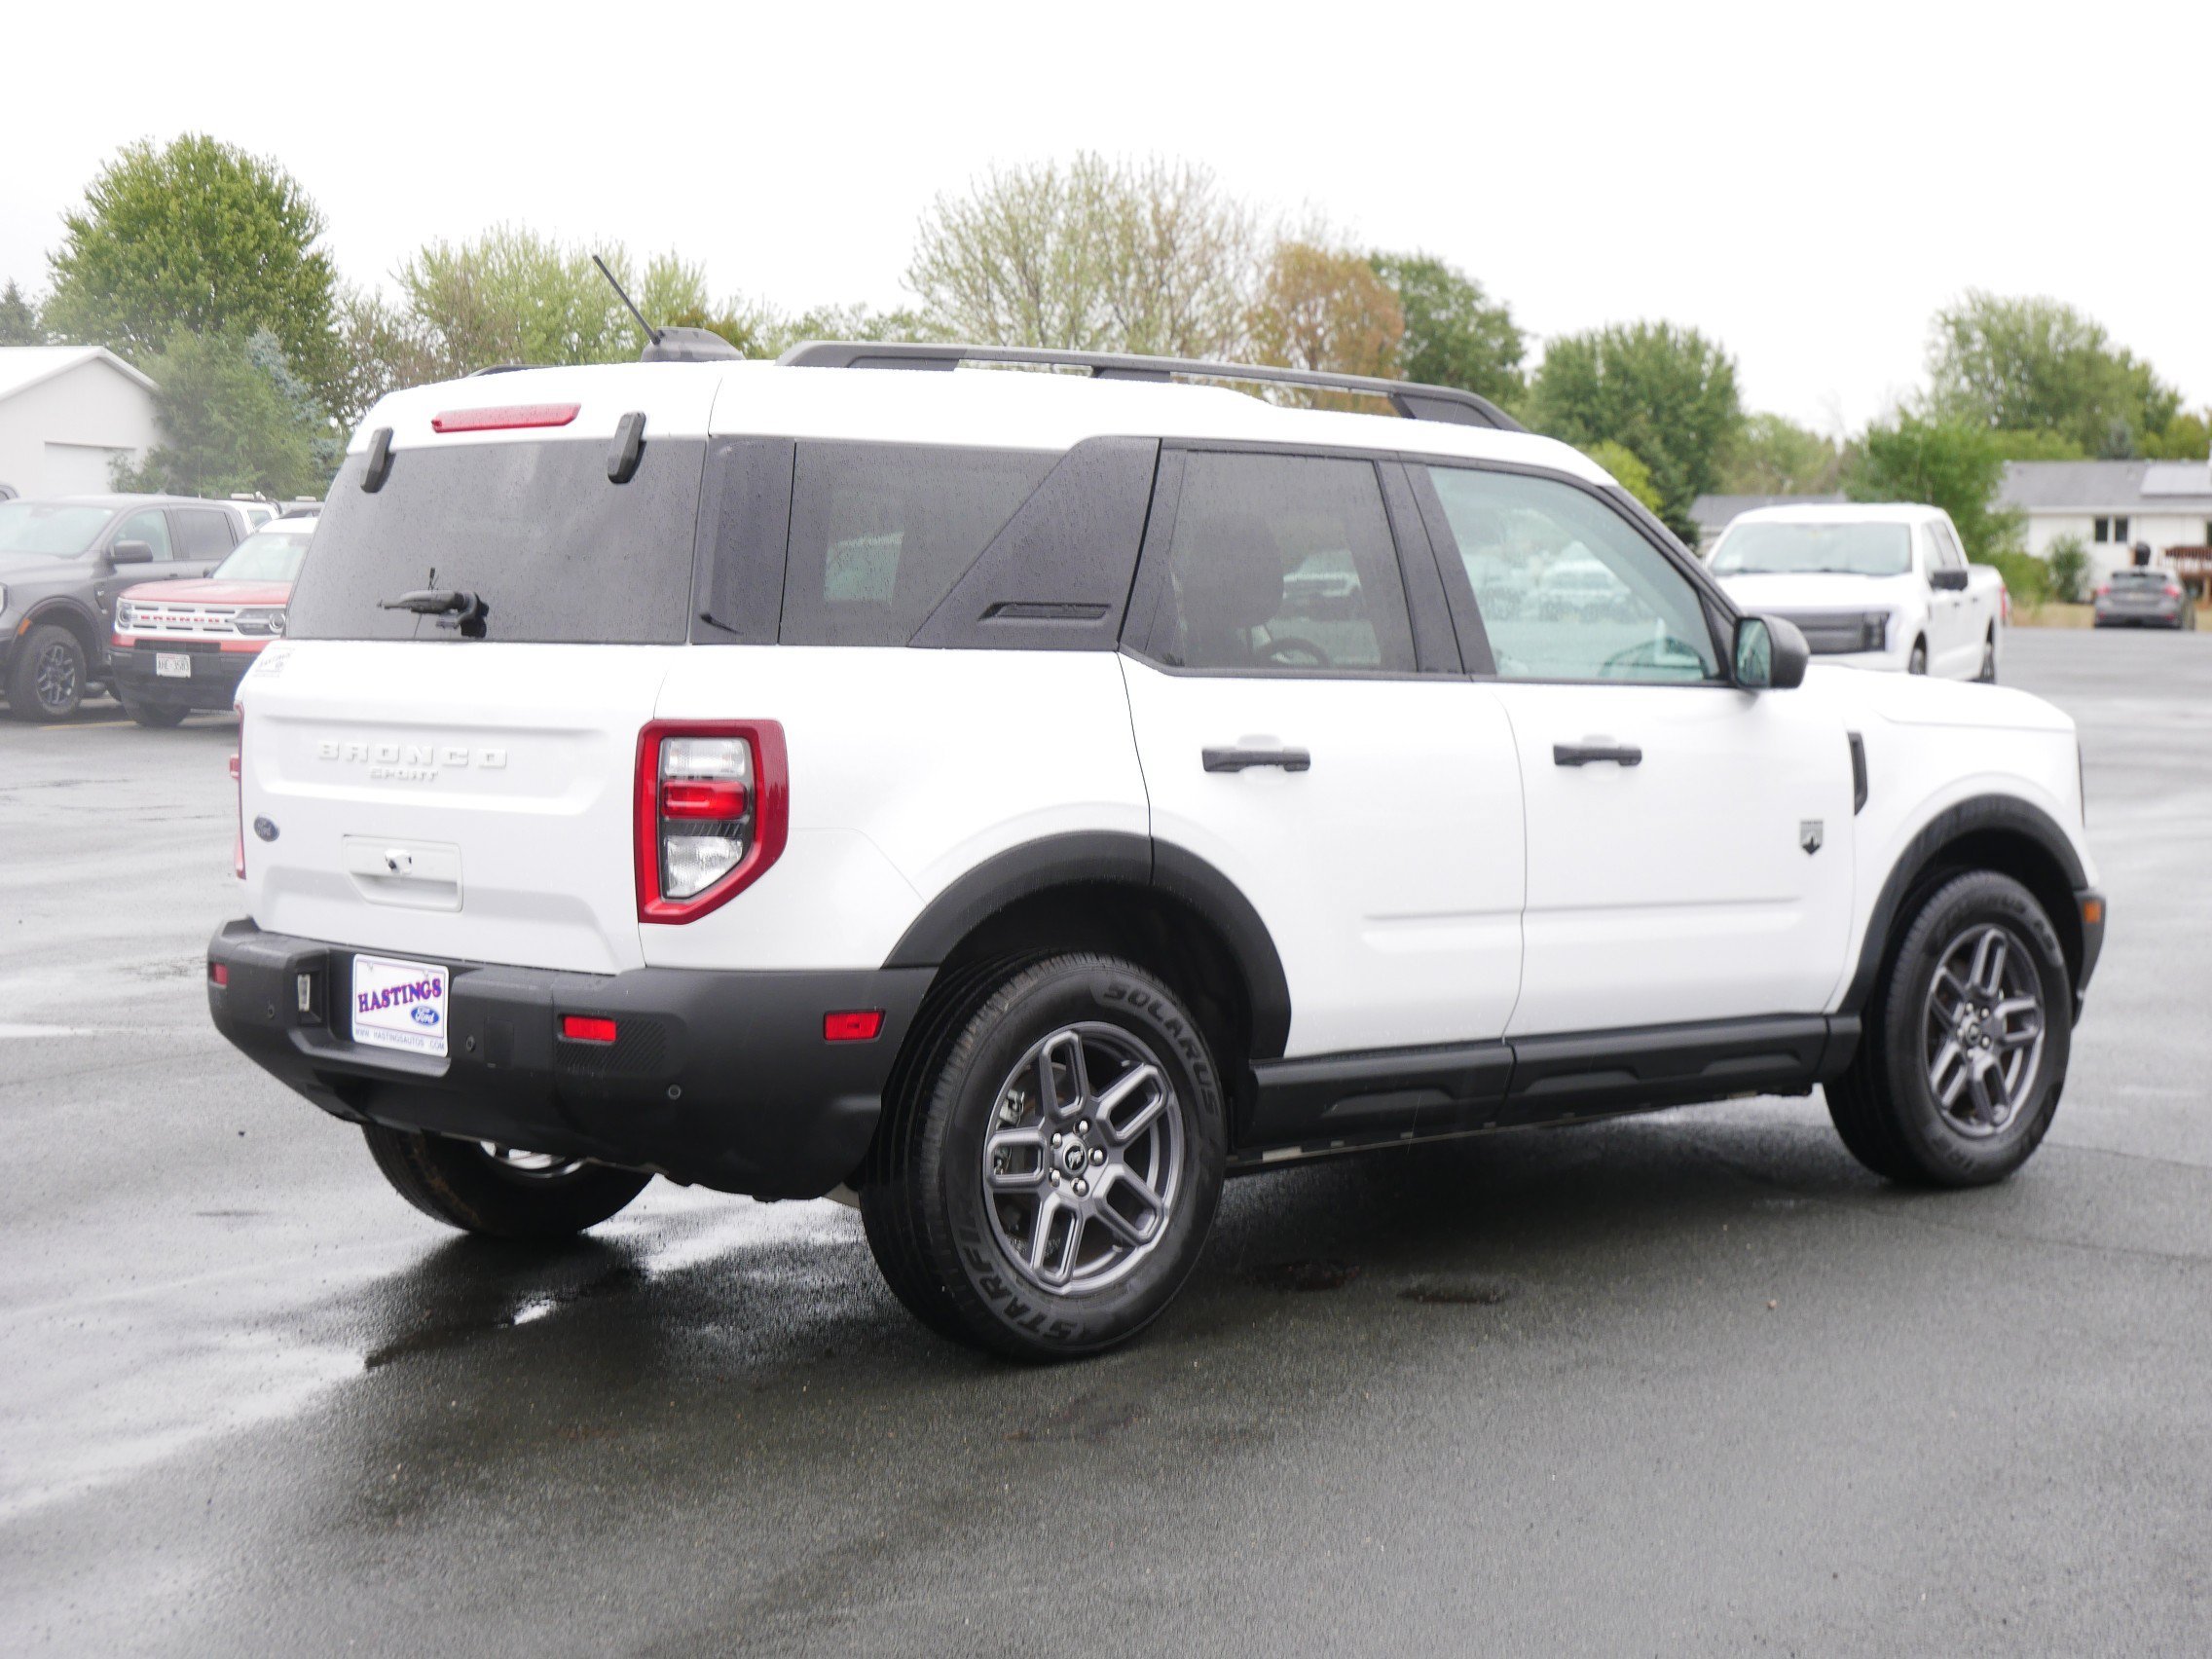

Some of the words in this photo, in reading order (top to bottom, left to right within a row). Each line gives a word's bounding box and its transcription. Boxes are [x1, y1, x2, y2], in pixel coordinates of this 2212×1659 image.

[317, 740, 507, 770] BRONCO
[370, 765, 439, 783] SPORT
[357, 977, 443, 1014] HASTINGS
[414, 1008, 436, 1025] Ford
[1103, 982, 1217, 1116] SOLARUS
[956, 1207, 1079, 1339] STARFI
